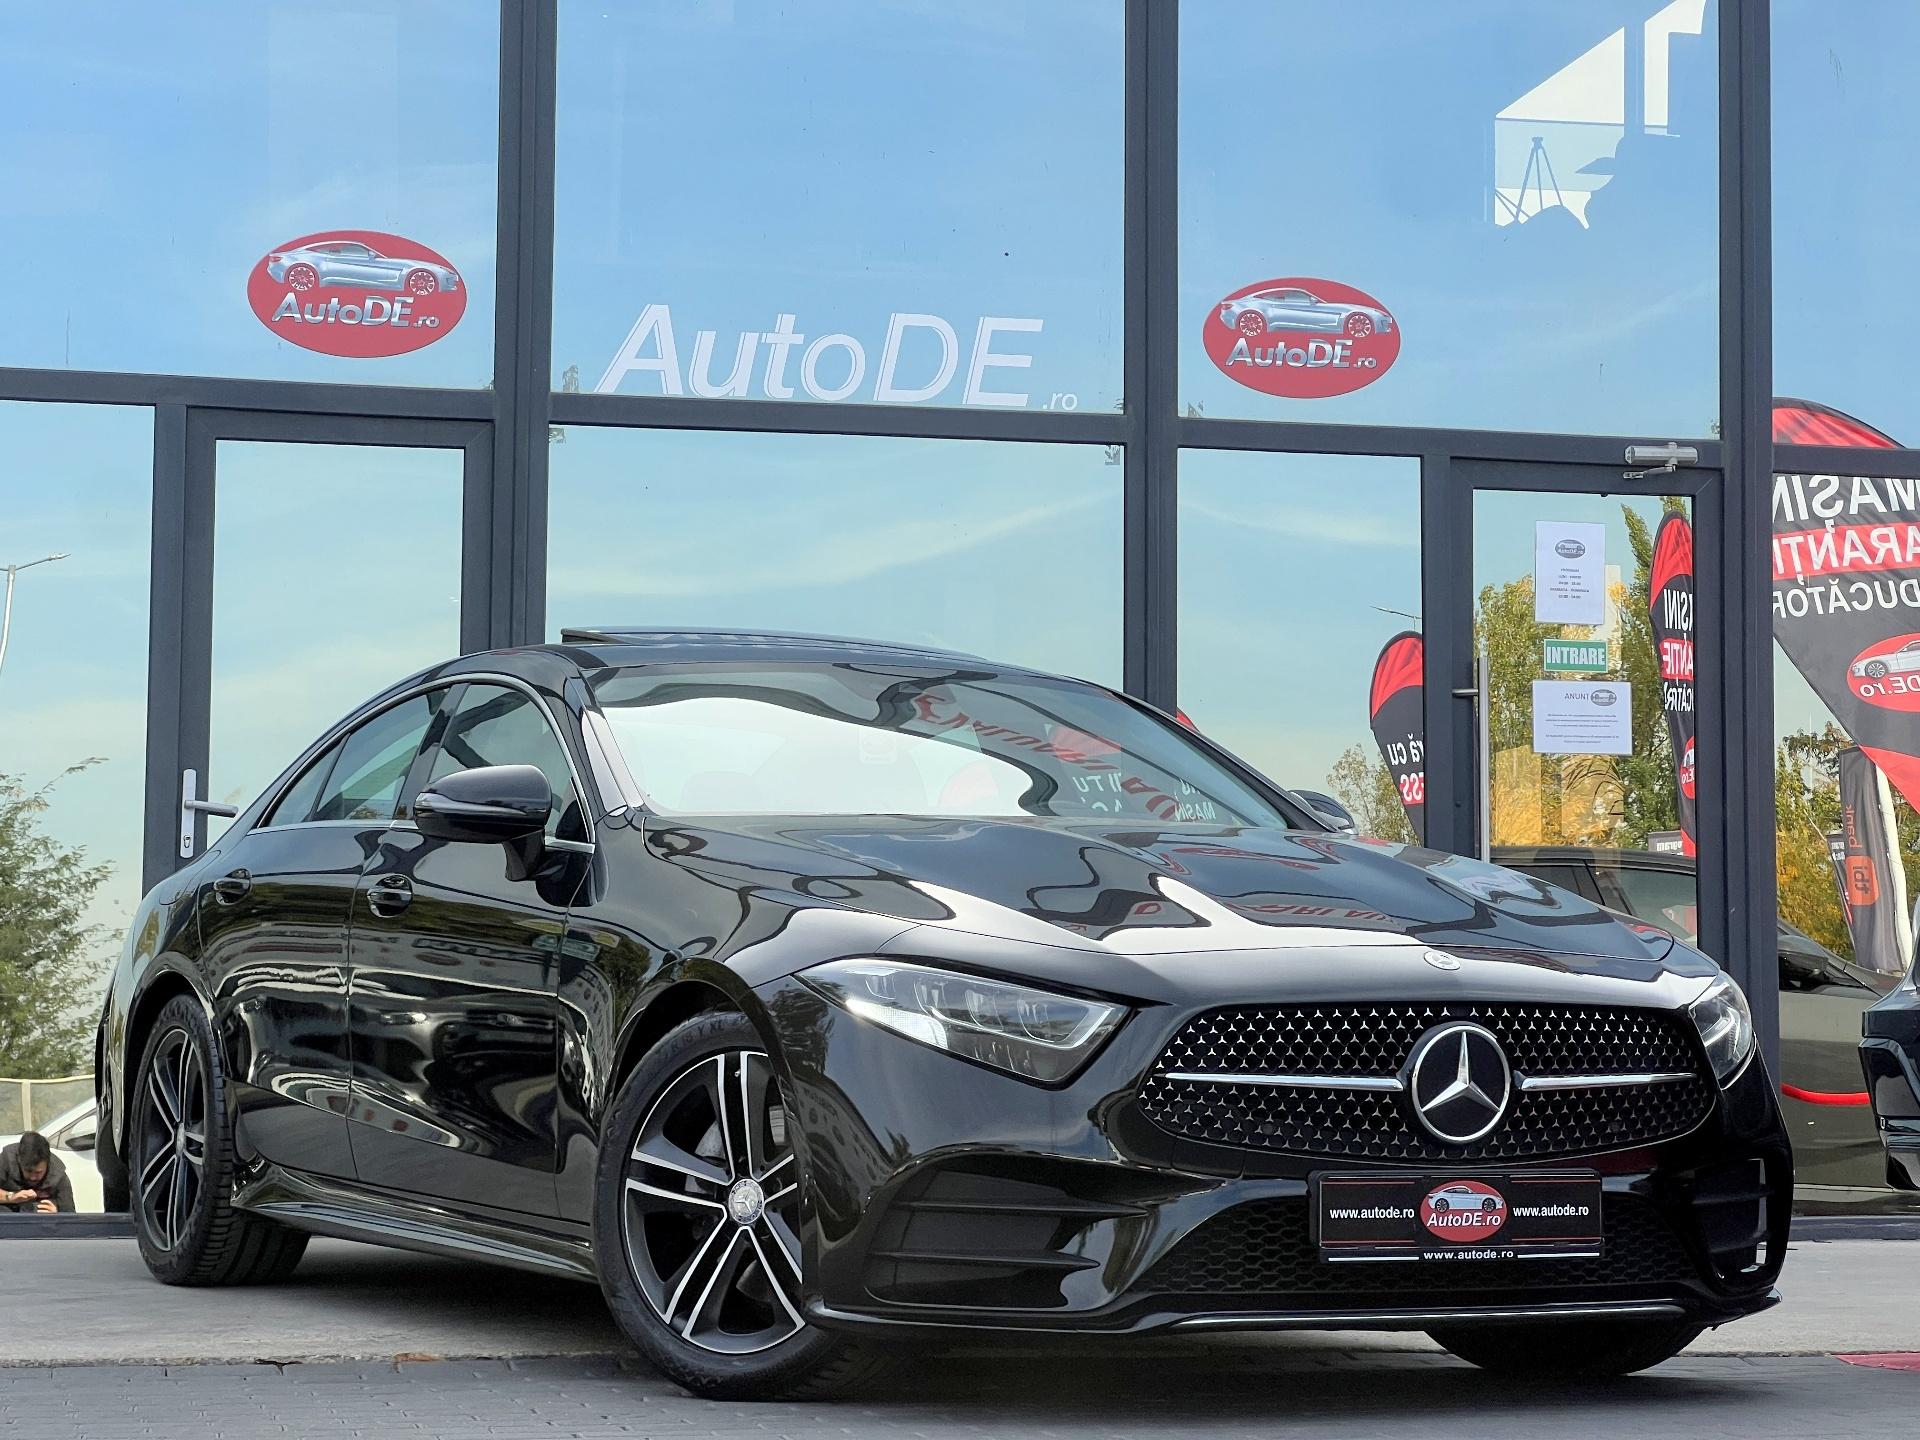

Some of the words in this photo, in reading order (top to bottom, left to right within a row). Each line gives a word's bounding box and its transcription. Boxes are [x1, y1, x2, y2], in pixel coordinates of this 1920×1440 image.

[1547, 646, 1605, 666] INTRARE
[1329, 1205, 1415, 1219] www.autode.ro
[1513, 1204, 1589, 1217] www.autode.ro
[1427, 1212, 1501, 1227] AutoDE.ro
[1424, 1249, 1514, 1260] www.autode.ro
